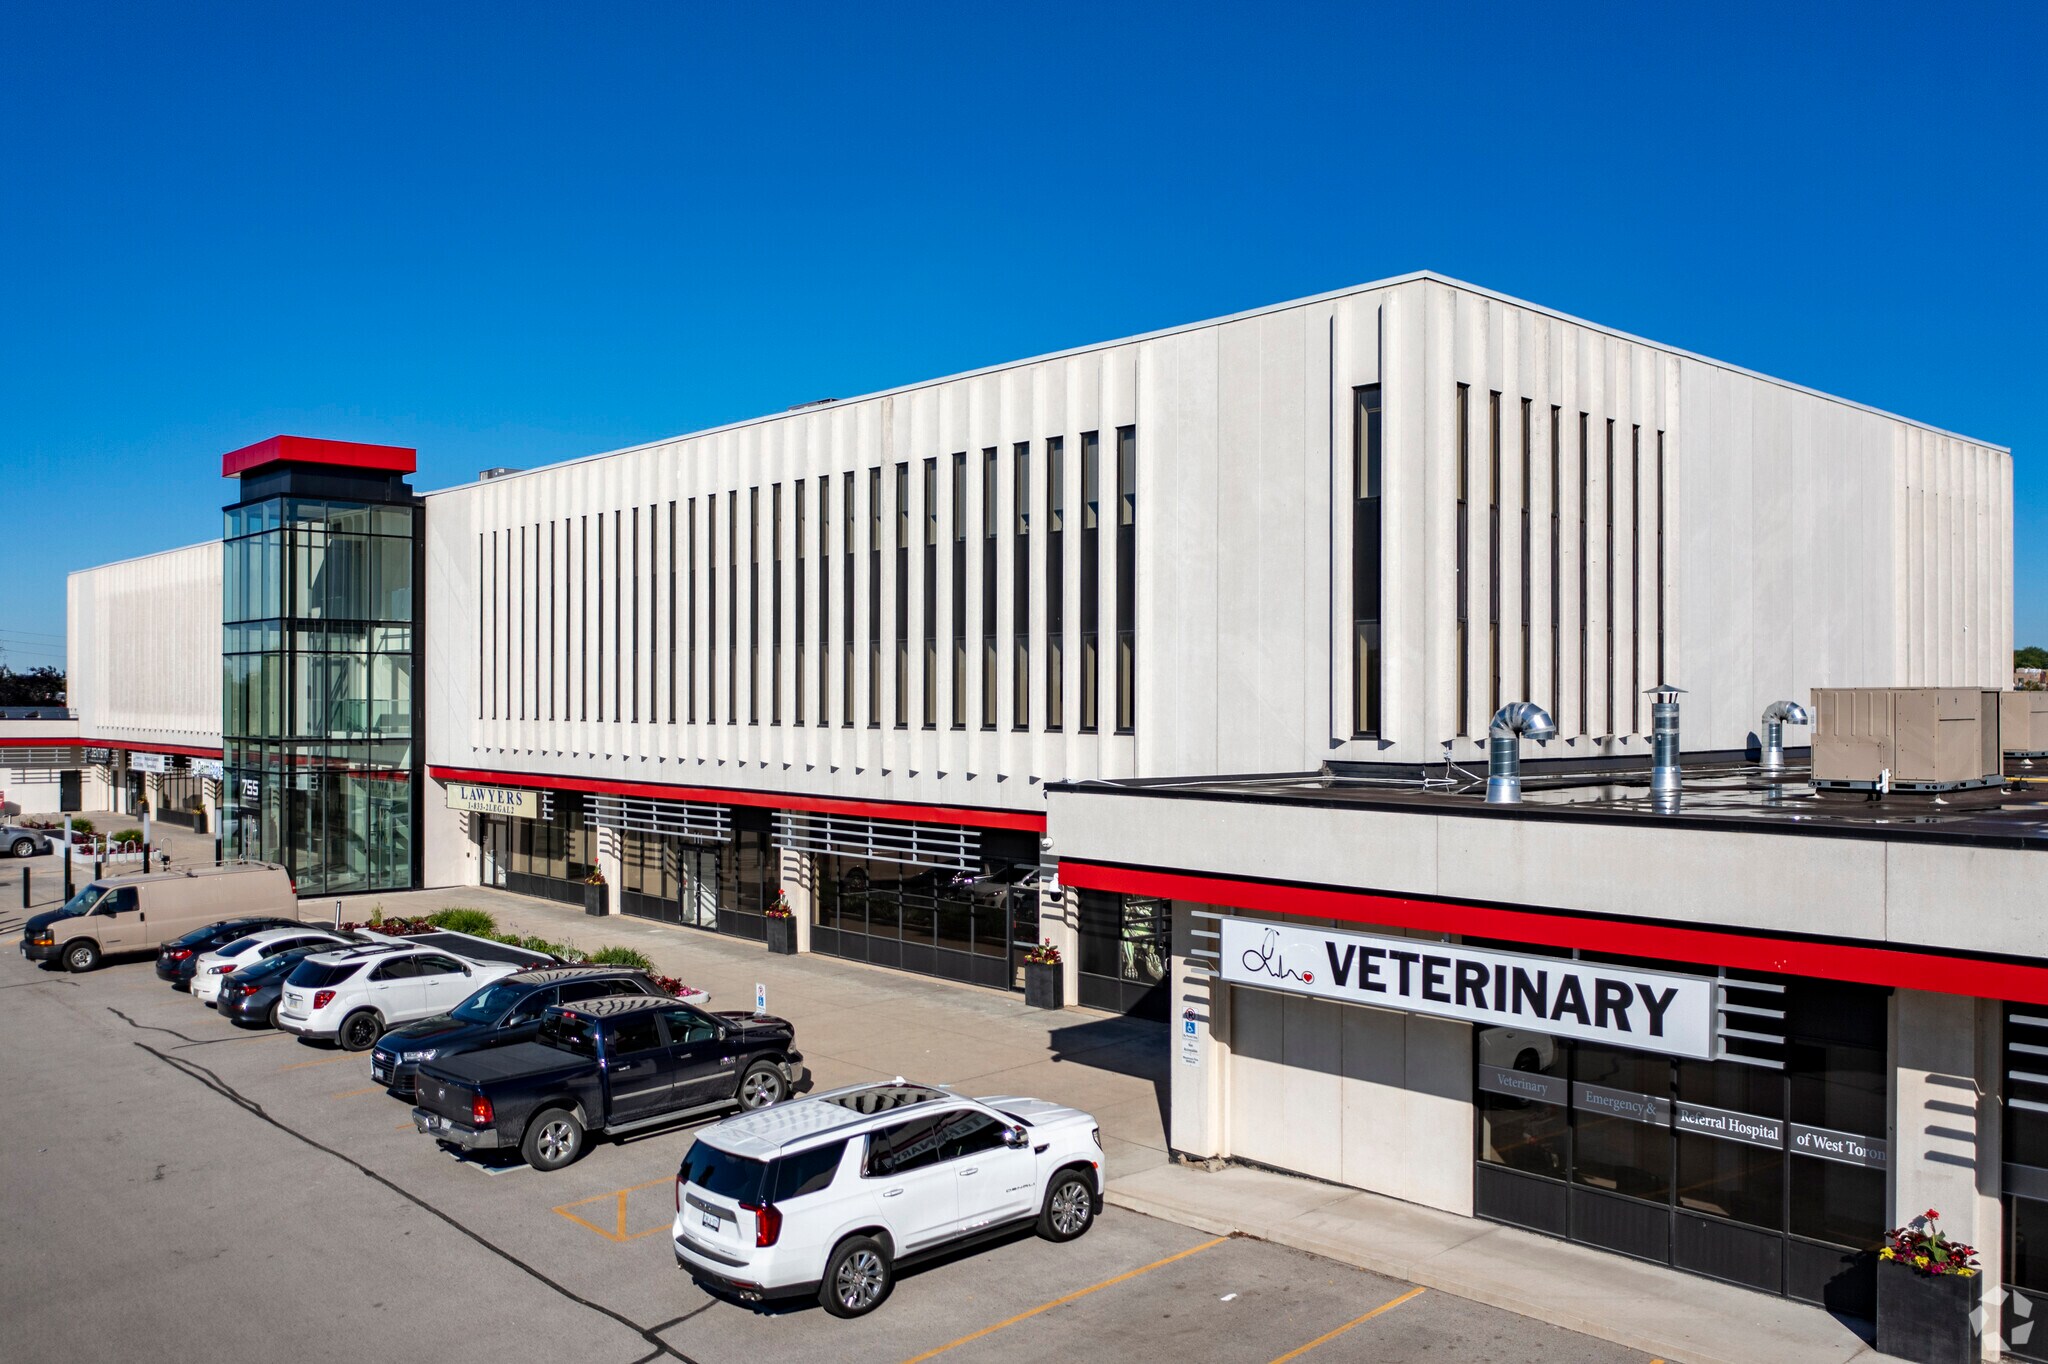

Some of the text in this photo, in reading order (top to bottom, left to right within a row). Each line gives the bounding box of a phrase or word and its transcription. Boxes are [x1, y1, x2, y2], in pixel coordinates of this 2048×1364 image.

[241, 779, 259, 796] 755
[461, 787, 523, 806] LAWYERS
[468, 802, 515, 814] 1-833-2LEGAL2
[1325, 941, 1679, 1037] VETERINARY
[1497, 1073, 1548, 1096] Veterinary
[1585, 1091, 1644, 1115] Emergency
[1646, 1102, 1656, 1115] &
[1680, 1109, 1726, 1130] Referral
[1728, 1118, 1779, 1141] Hospital
[1796, 1132, 1811, 1147] of
[1812, 1134, 1843, 1153] West
